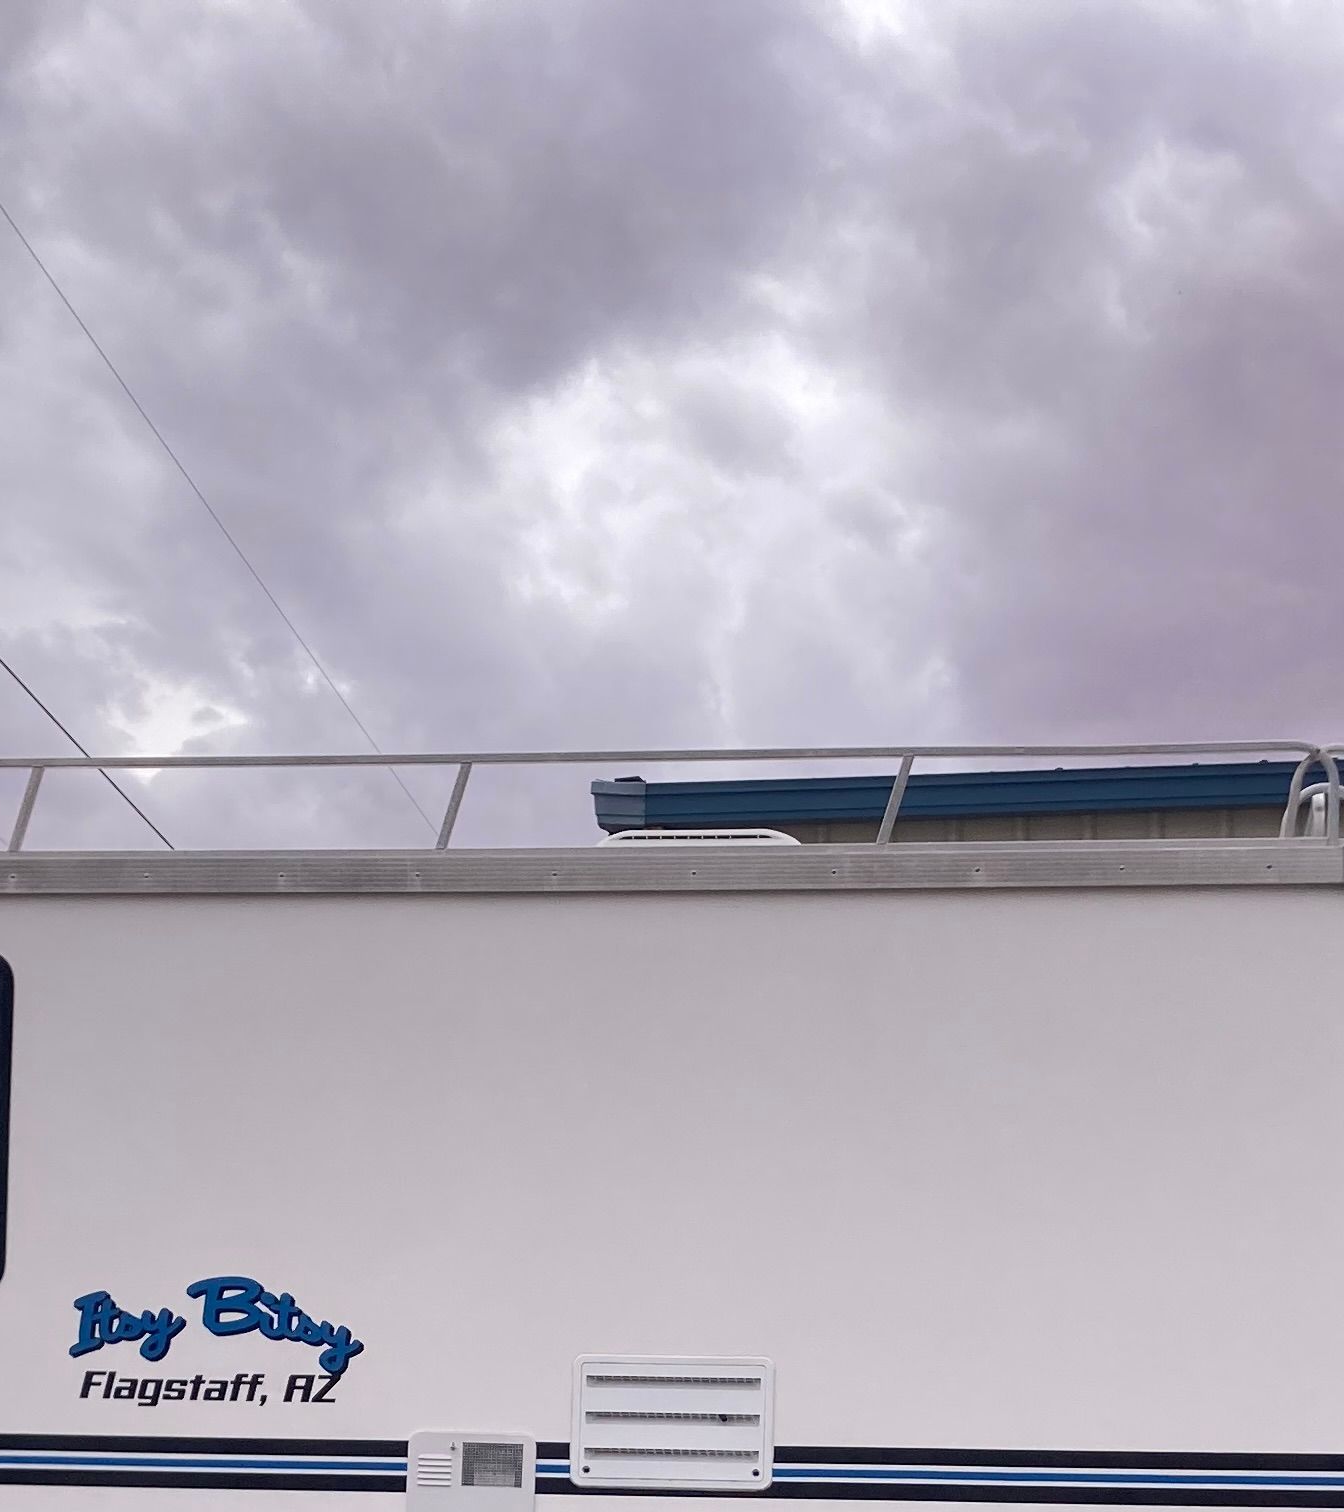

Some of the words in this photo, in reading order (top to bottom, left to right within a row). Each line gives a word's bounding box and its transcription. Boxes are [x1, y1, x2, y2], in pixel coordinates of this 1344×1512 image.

[69, 1291, 186, 1362] Itsy
[187, 1276, 364, 1376] Bitsy
[79, 1371, 268, 1406] Flagstaff,
[283, 1374, 341, 1403] AZ
